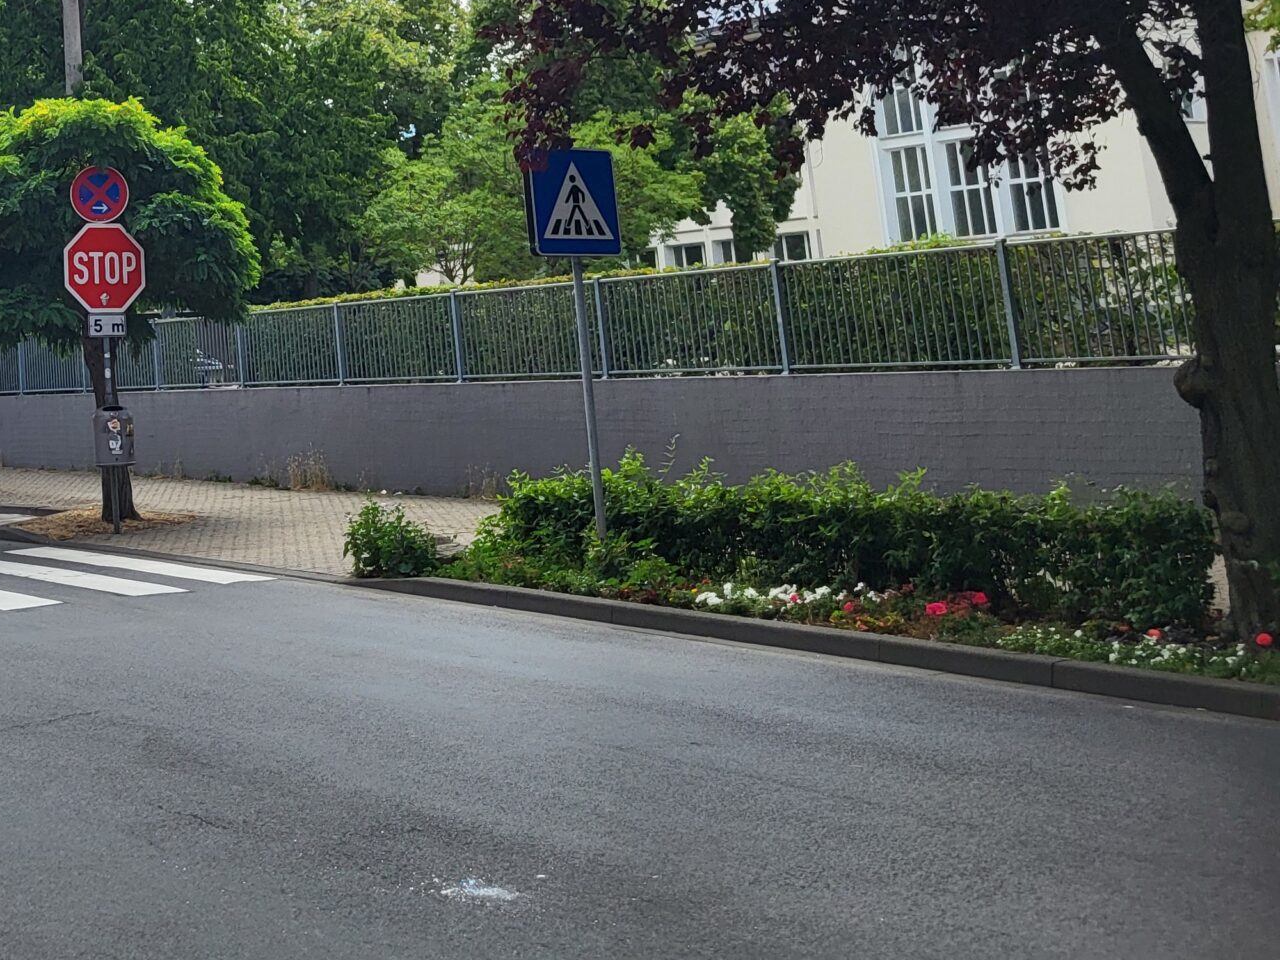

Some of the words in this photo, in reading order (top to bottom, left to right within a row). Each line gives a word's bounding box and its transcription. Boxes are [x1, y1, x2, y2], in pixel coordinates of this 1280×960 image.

[73, 251, 136, 285] STOP
[94, 319, 103, 333] 5
[112, 322, 124, 333] m
